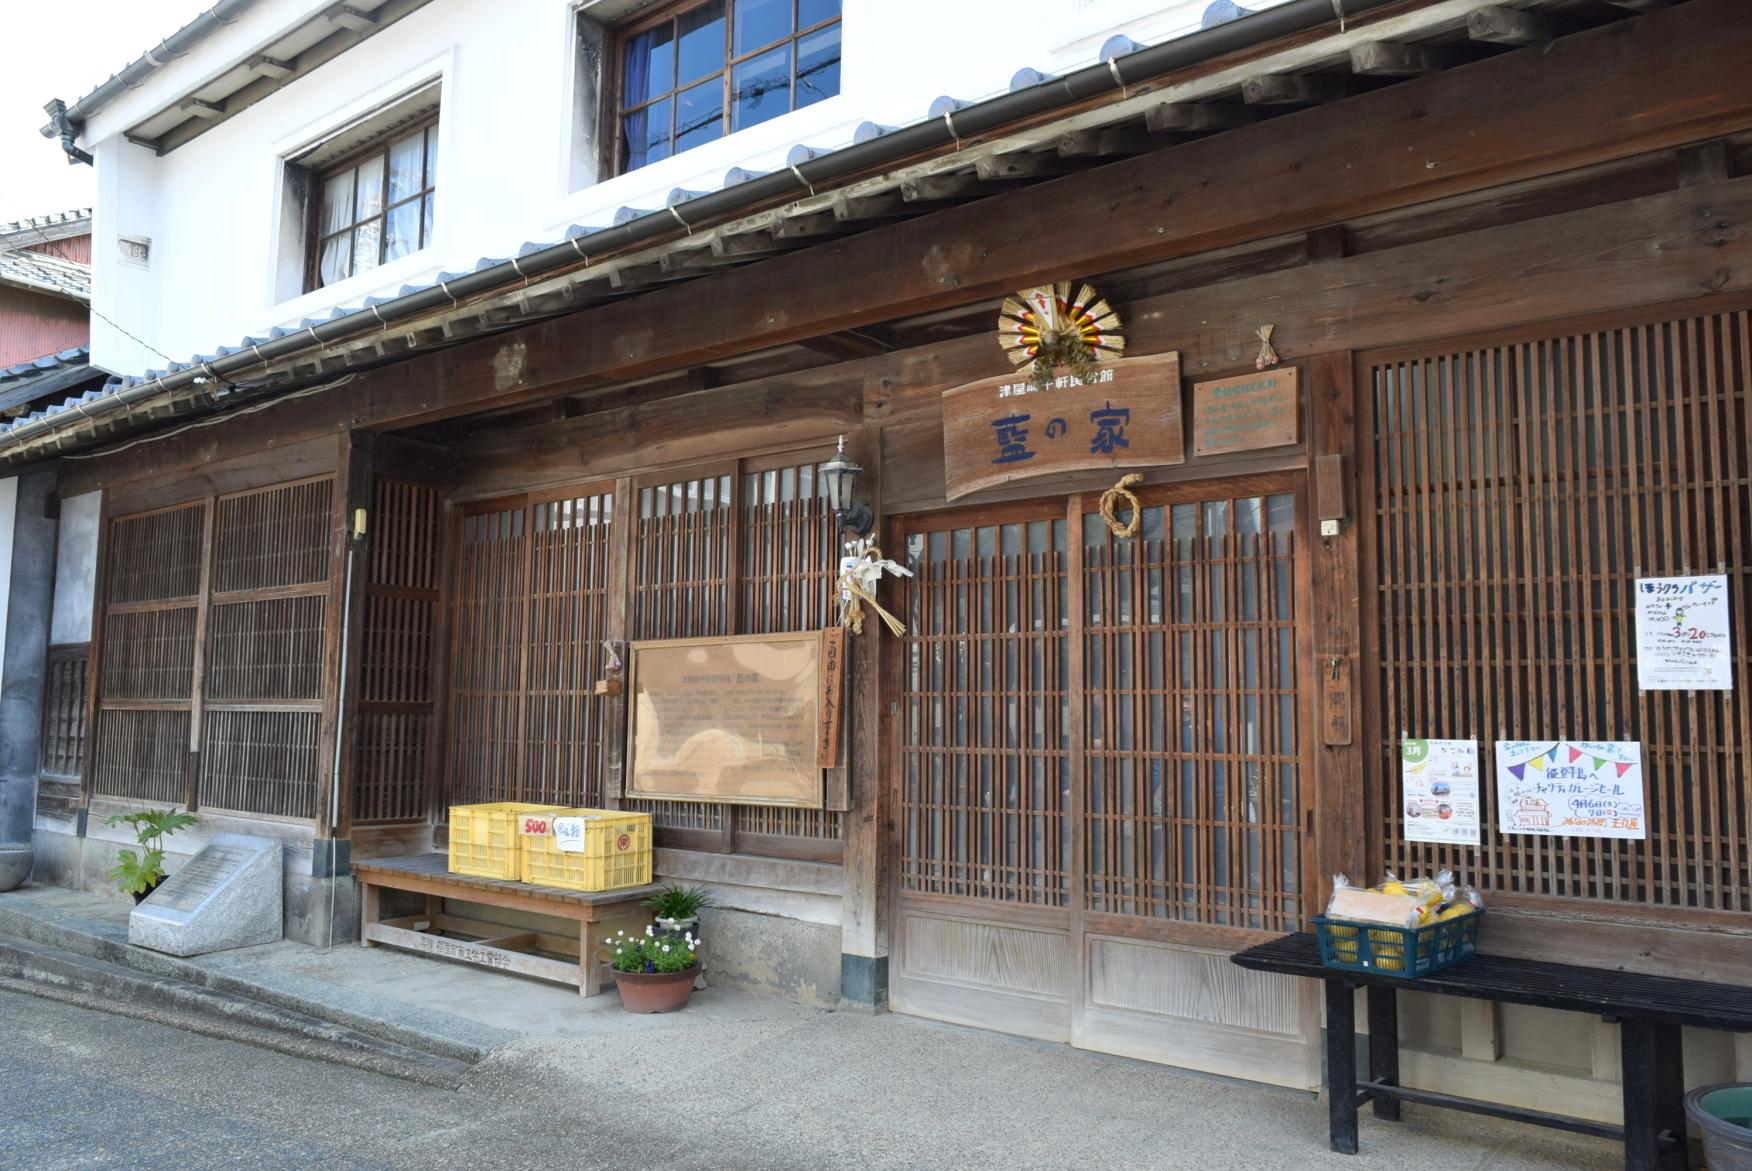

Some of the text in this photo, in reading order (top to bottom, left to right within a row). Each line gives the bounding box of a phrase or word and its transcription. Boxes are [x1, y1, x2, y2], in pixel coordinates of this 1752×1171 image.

[991, 401, 1130, 464] 藍の家
[525, 819, 547, 834] 500
